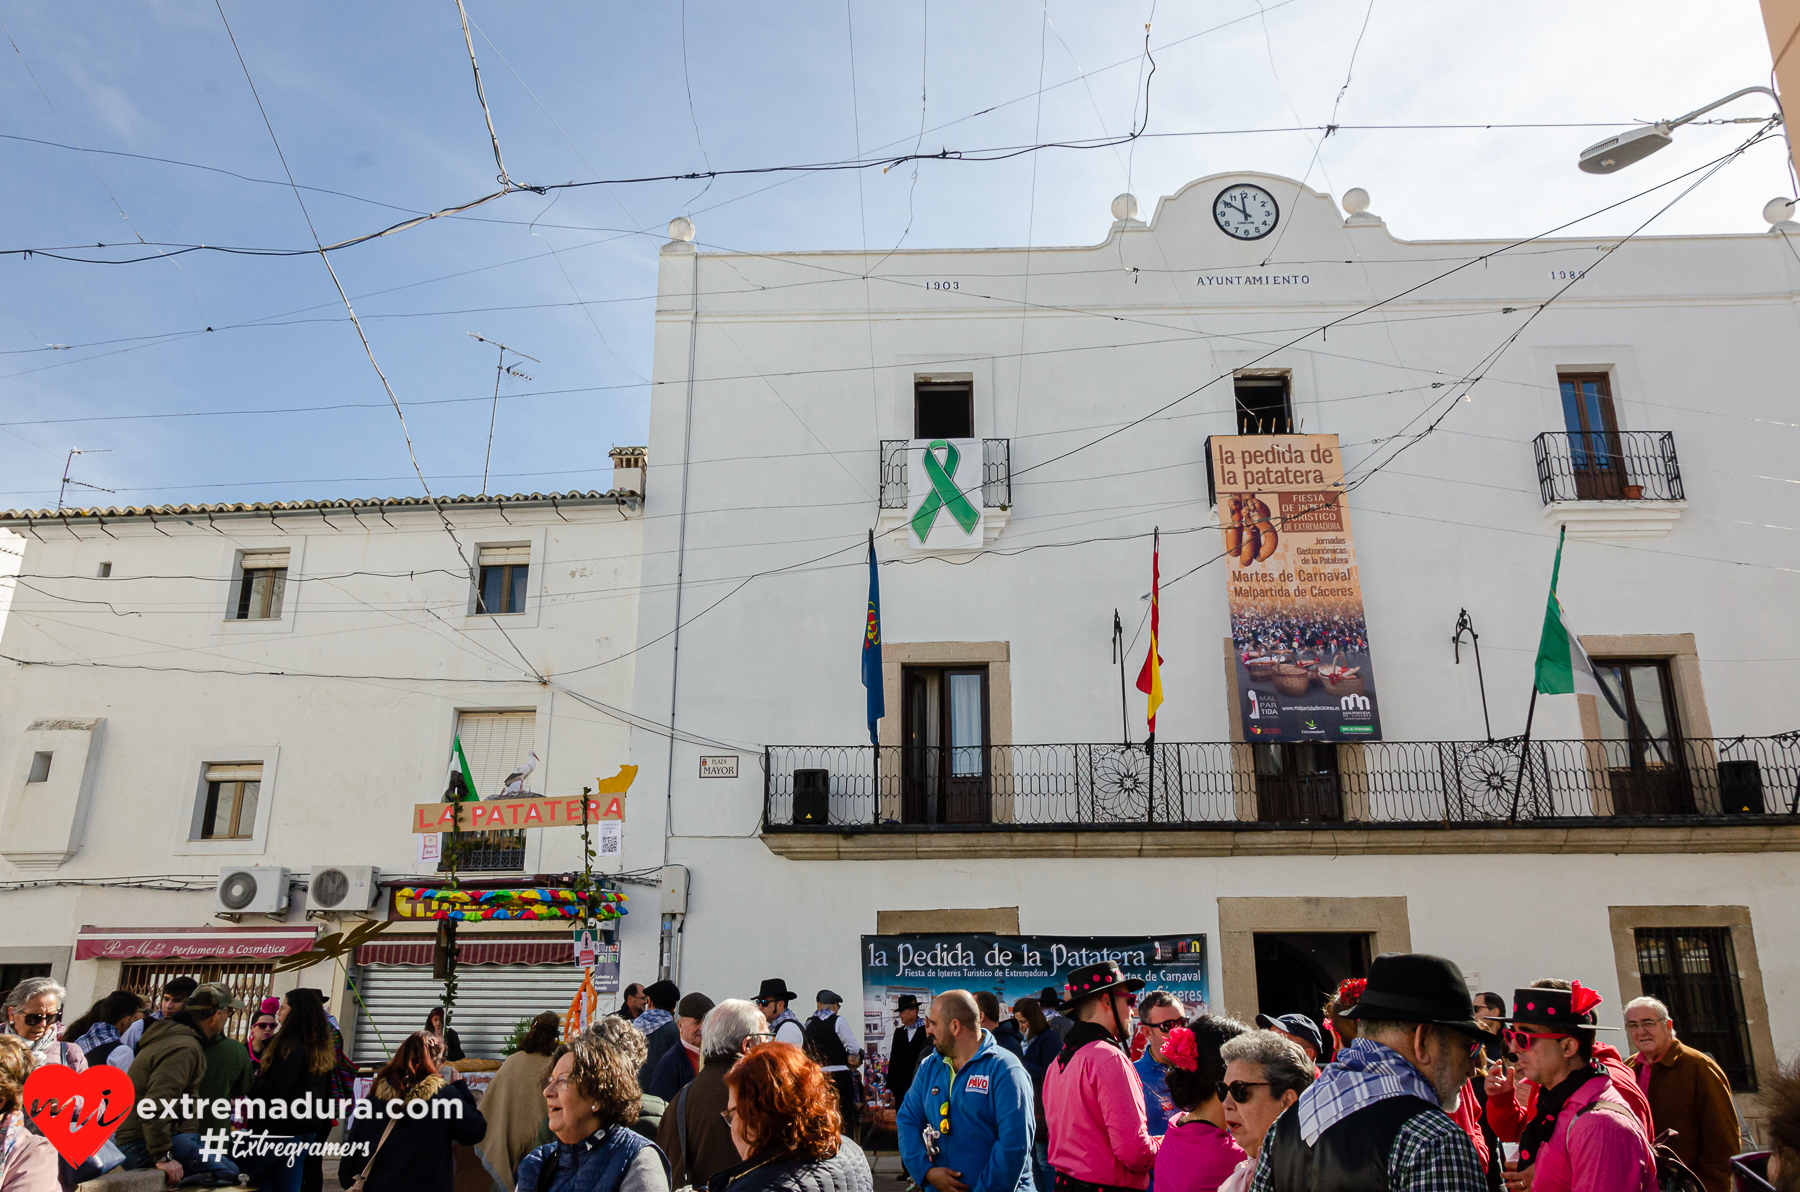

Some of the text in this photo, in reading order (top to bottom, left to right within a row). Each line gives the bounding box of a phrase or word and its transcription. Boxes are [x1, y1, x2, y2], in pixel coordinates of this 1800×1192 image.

[925, 281, 960, 290] 1903
[1197, 275, 1310, 286] AYUNTAMIENTO
[1219, 443, 1334, 470] la pedida de
[1221, 465, 1325, 490] la patatera
[1292, 494, 1325, 503] FIESTA
[1282, 504, 1295, 512] DE
[1283, 522, 1341, 531] DE EXTREMADURA
[1315, 536, 1346, 545] Jornadas
[1296, 546, 1348, 556] Gastronómicas
[1301, 557, 1349, 565] de la Patatera
[1232, 568, 1351, 582] Martes de Carnaval
[1234, 585, 1354, 600] Malpartida de Cáceres
[703, 766, 735, 775] MAYOR
[418, 796, 623, 829] LA PATATERA
[171, 945, 225, 956] Perfumería
[227, 945, 235, 954] &
[236, 944, 286, 954] Cosmética
[868, 942, 889, 967] la
[984, 942, 1012, 966] de
[1021, 942, 1042, 967] la
[905, 969, 925, 977] Fiesta
[927, 969, 936, 977] de
[994, 969, 1003, 977] de
[1005, 969, 1048, 979] Extremadura
[1145, 970, 1157, 982] de
[1160, 969, 1201, 983] Carnaval
[967, 1078, 988, 1089] PAVO
